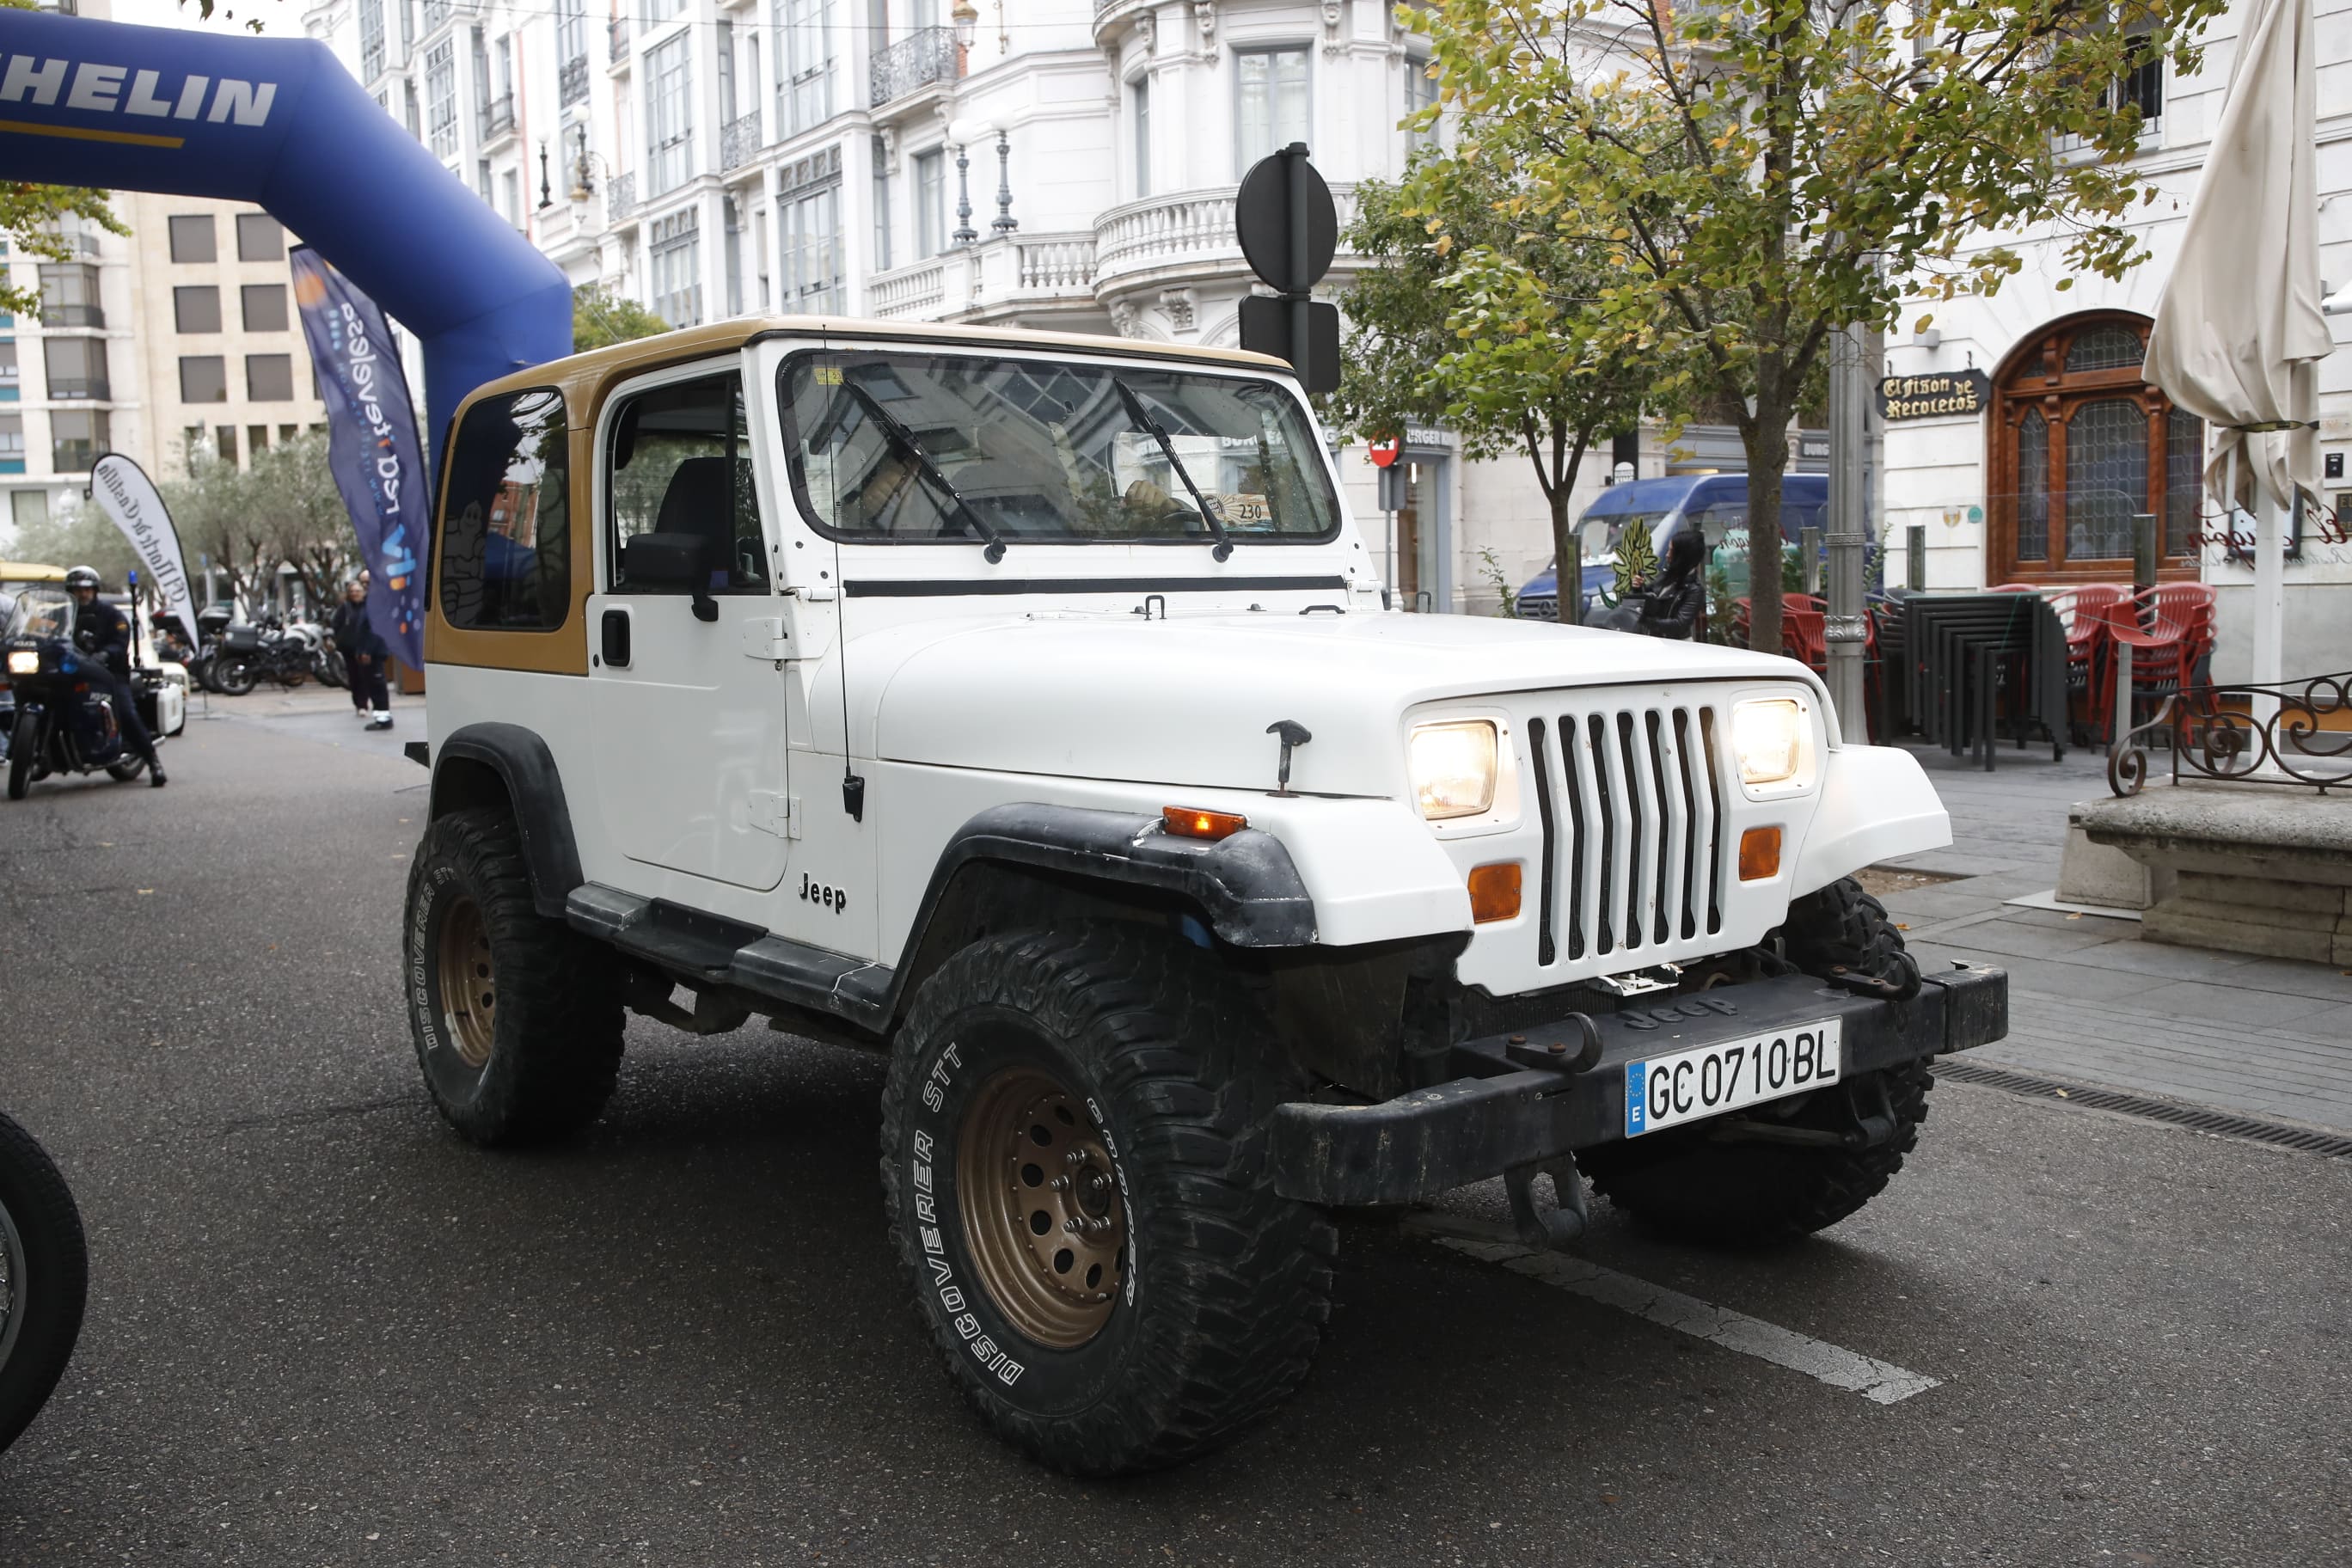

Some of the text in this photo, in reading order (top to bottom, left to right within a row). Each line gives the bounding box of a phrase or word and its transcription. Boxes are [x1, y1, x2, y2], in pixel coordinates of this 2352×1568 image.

[0, 53, 278, 127] HELIN
[1883, 378, 1902, 398] El
[1954, 379, 1975, 396] de
[1885, 393, 1979, 419] Recoletos
[1406, 428, 1441, 445] URGER
[1239, 503, 1262, 519] 230
[799, 873, 847, 916] Jeep
[414, 882, 438, 1050] DISCOVERER
[1616, 997, 1737, 1030] Jeep
[1632, 1106, 1641, 1123] E
[914, 1042, 1025, 1386] DISCOVERER STT
